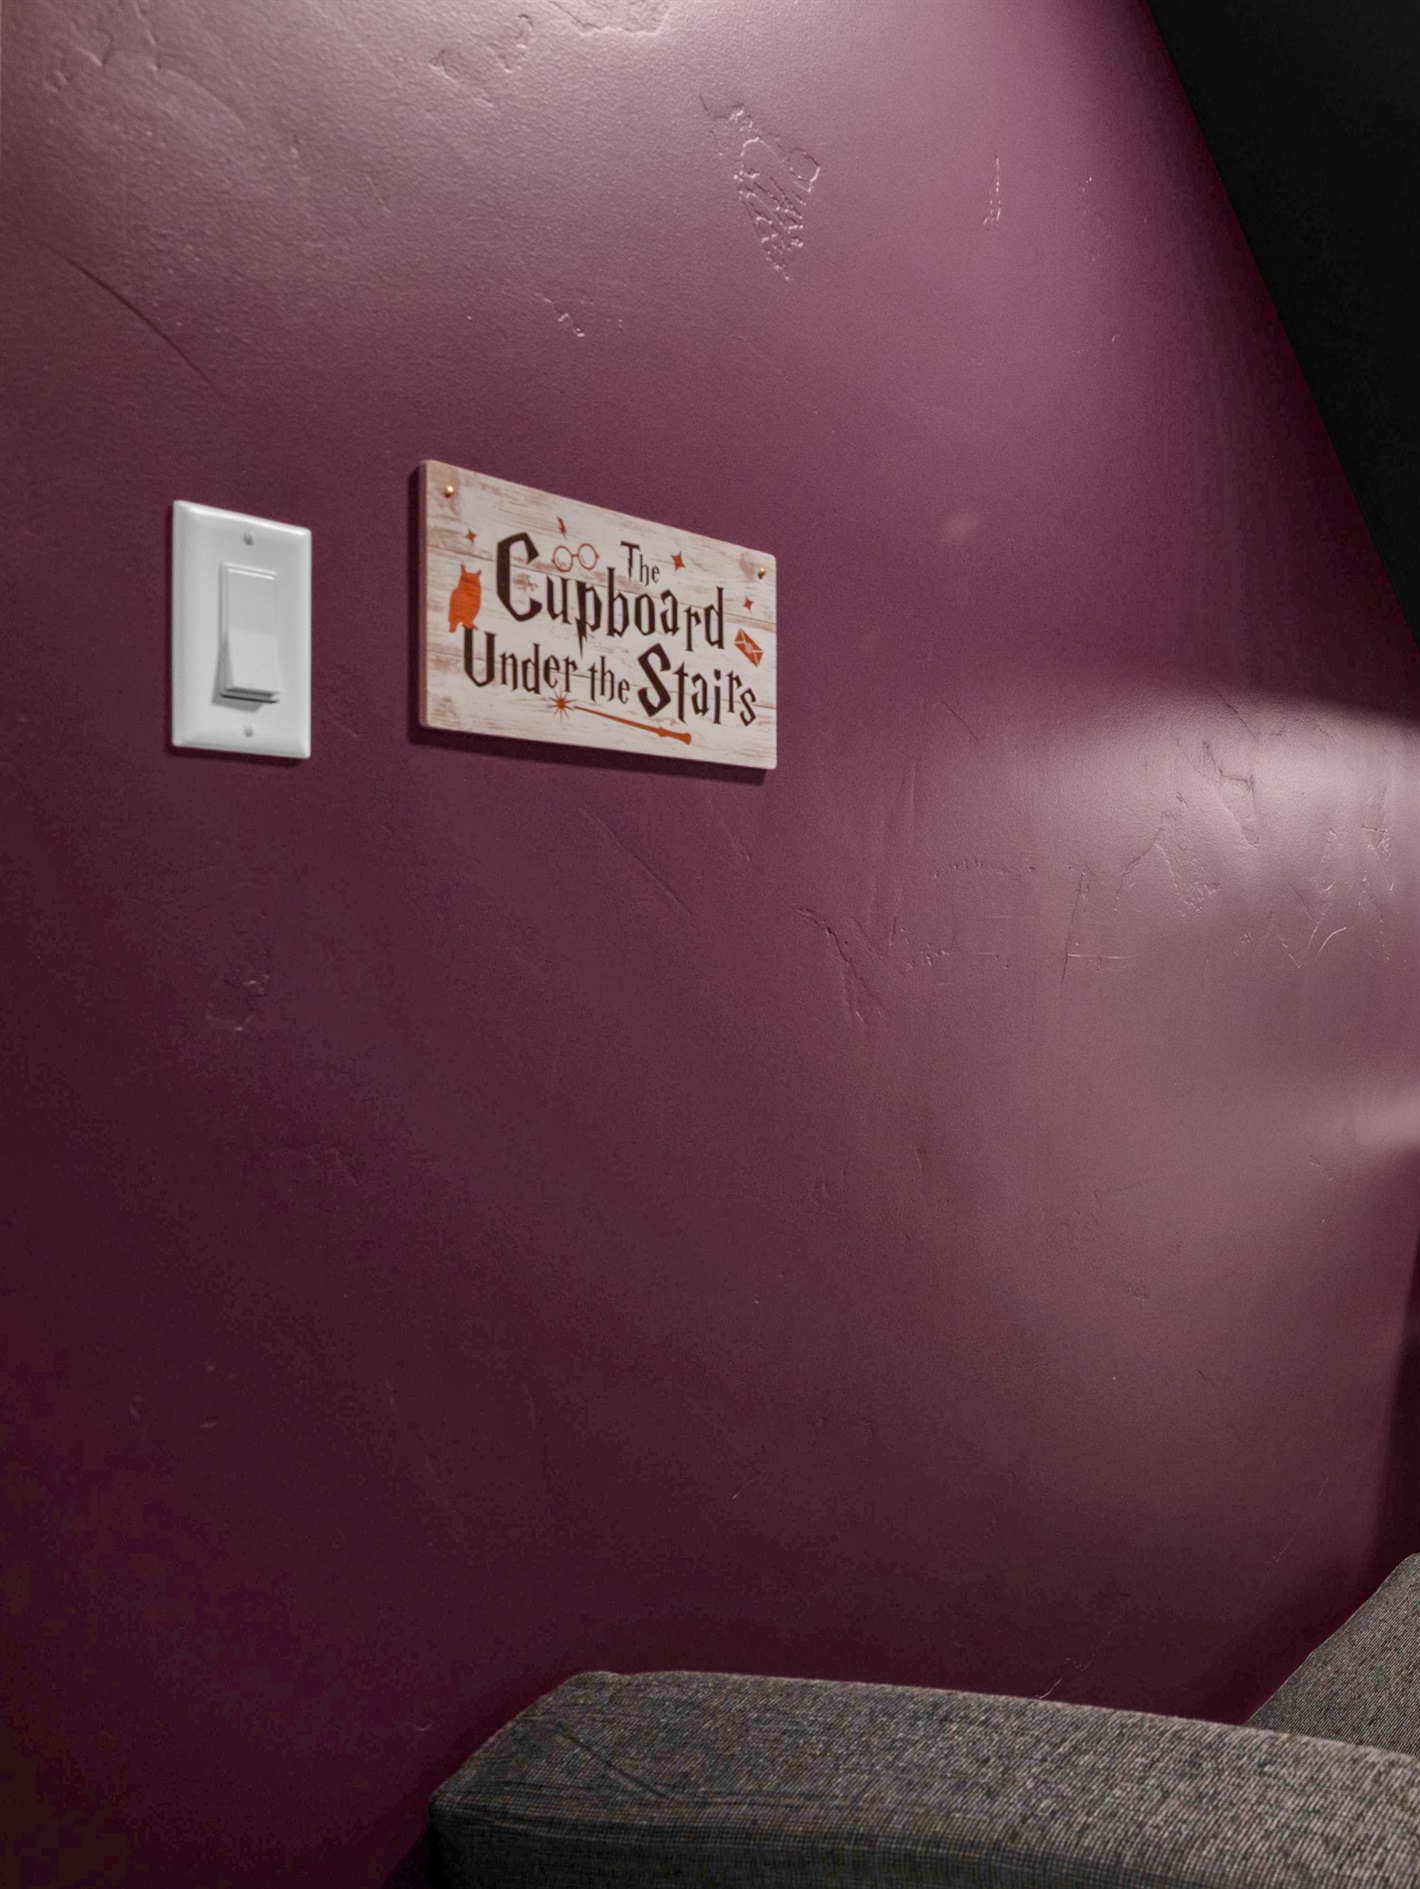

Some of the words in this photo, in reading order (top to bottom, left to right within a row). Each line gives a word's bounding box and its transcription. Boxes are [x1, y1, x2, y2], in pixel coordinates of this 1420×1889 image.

[496, 531, 725, 657] Cupboard
[620, 540, 660, 587] The
[463, 626, 578, 695] Under
[588, 655, 630, 704] the
[637, 642, 757, 727] Stairs
